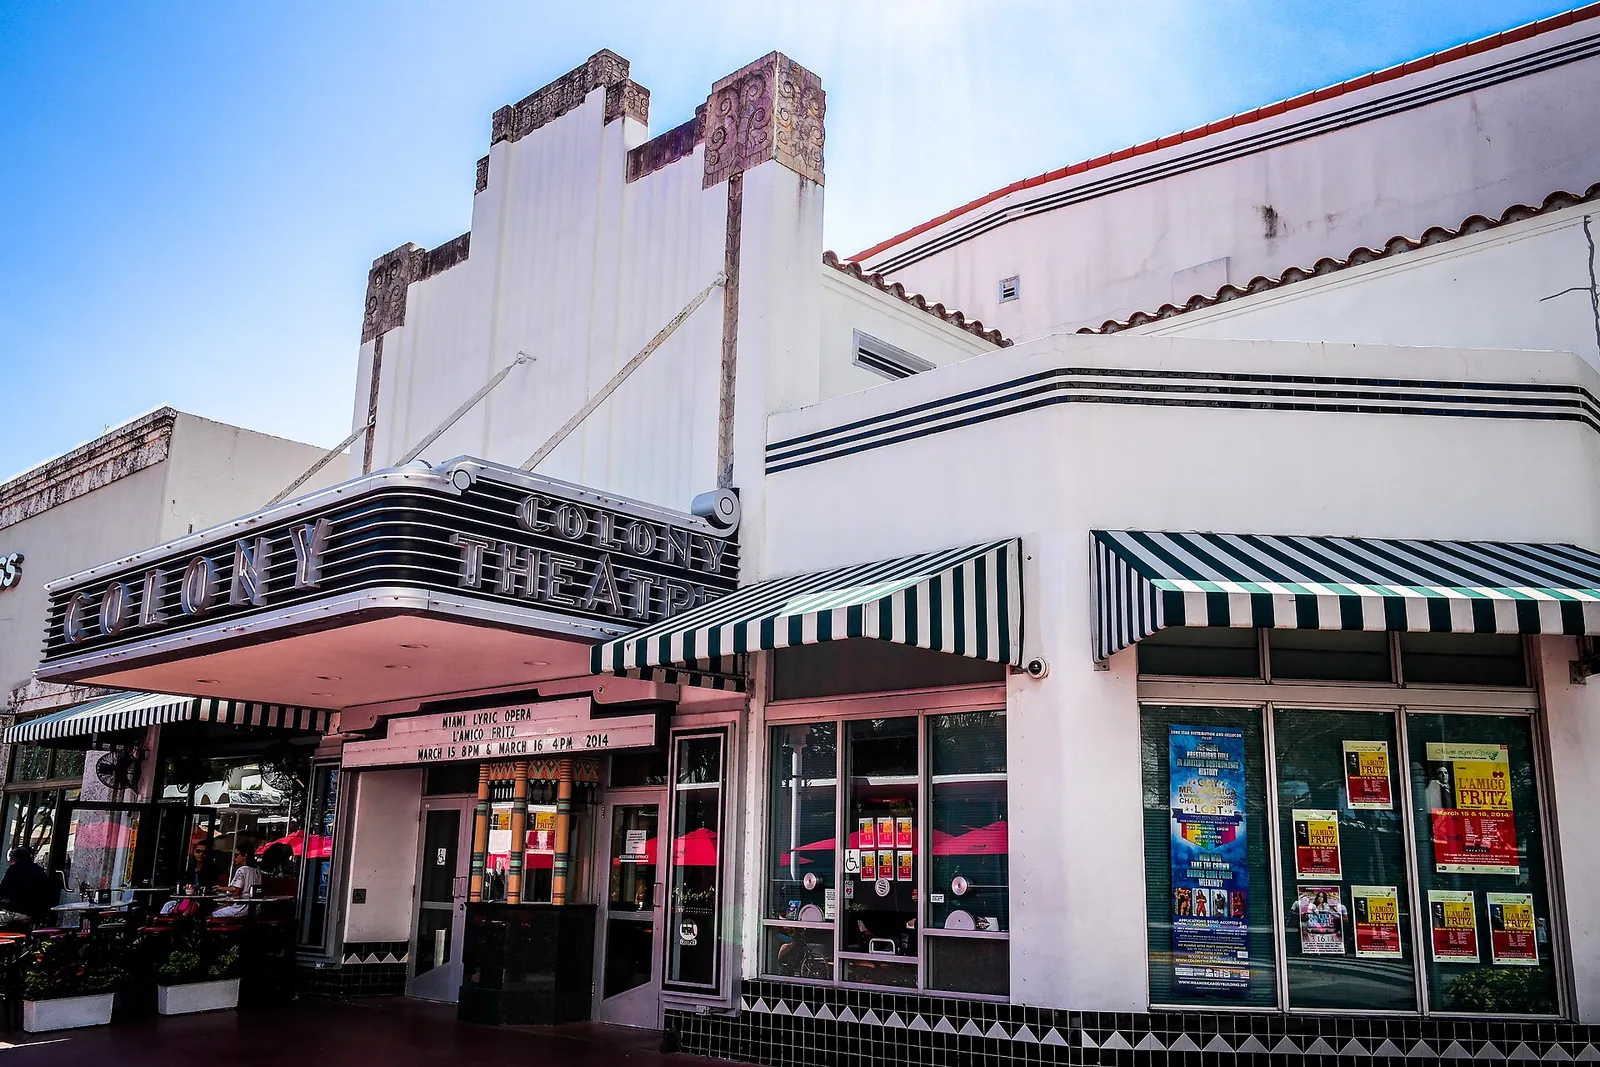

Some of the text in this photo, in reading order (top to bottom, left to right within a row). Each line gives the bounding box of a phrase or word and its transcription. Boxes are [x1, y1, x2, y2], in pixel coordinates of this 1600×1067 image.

[514, 494, 729, 573] COLONY
[63, 518, 334, 645] COLONY
[449, 533, 726, 620] THEATR
[442, 708, 532, 728] MIAMI LYRIC OPERA
[452, 726, 515, 743] L'AMICO FRITZ
[417, 733, 609, 761] MARCH 15 8PM & MARCH 16 4PM 2014
[1361, 766, 1386, 774] FRITZ
[1197, 778, 1219, 787] GAY
[1458, 777, 1506, 790] L'AMICO
[1459, 790, 1508, 806] FRITZ
[1194, 805, 1224, 814] LGBT
[1310, 835, 1336, 844] FRITZ
[1370, 912, 1395, 921] FRITZ
[1446, 917, 1472, 926] FRITZ
[1505, 919, 1531, 928] FRITZ
